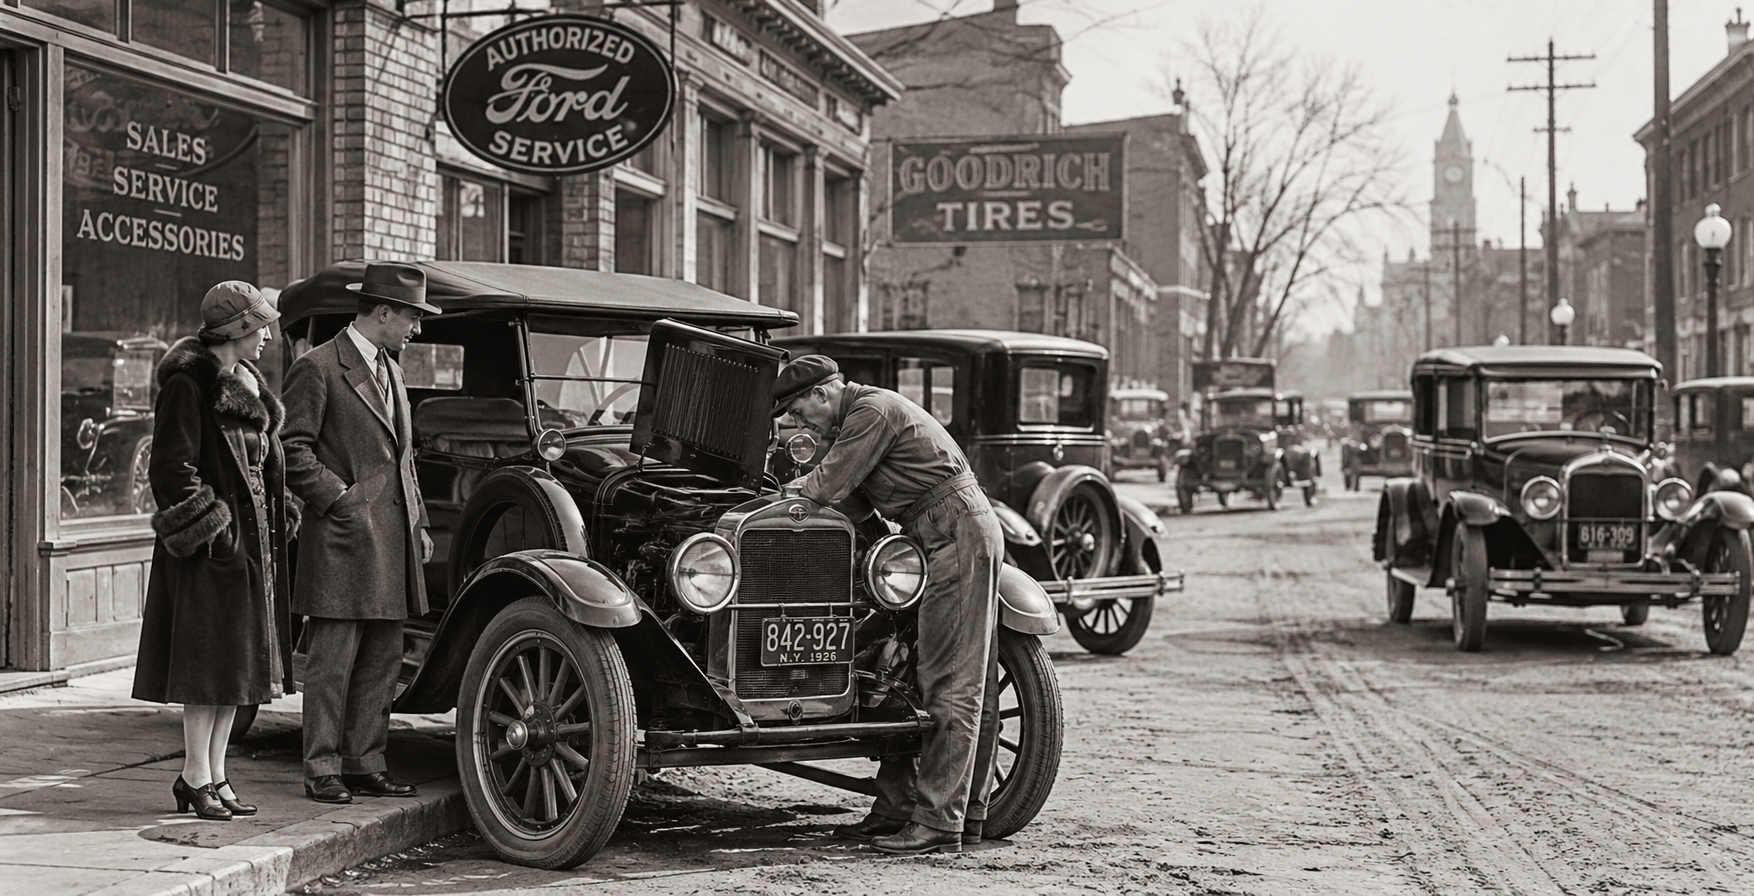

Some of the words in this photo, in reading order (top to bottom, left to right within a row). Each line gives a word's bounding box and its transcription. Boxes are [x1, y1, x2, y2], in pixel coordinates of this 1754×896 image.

[486, 26, 635, 72] AUTHORIZED
[485, 63, 632, 124] Ford
[126, 121, 206, 165] SALES
[488, 124, 629, 165] SERVICE
[113, 167, 218, 213] SERVICE
[900, 152, 1111, 194] GOODRICH
[77, 209, 244, 261] ACCESSORIES
[937, 201, 1075, 232] TIRES
[779, 652, 805, 663] N.Y.
[810, 651, 837, 662] 1926
